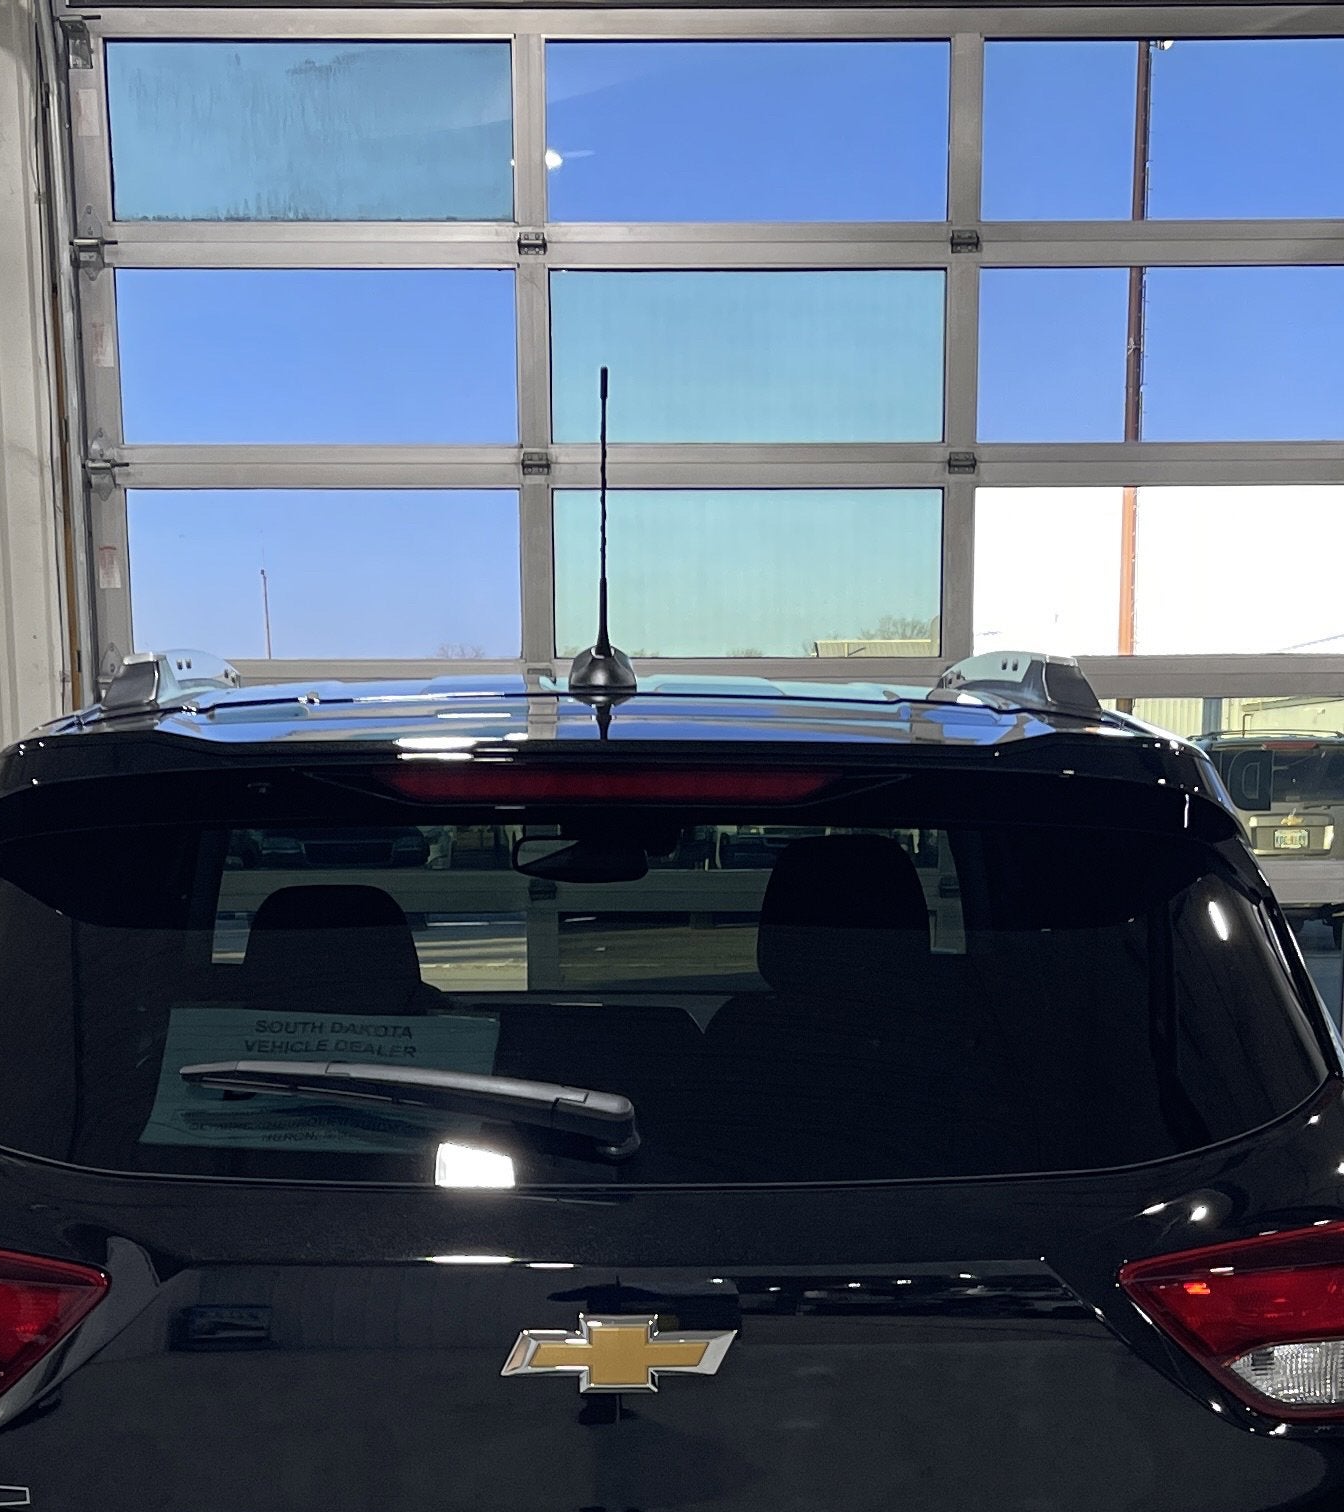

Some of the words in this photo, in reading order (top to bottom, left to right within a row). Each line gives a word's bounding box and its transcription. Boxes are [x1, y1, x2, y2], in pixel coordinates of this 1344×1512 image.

[256, 1019, 325, 1035] SOUTH
[330, 1020, 413, 1040] DAKOTA
[243, 1039, 327, 1054] VEHICLE
[334, 1040, 416, 1059] DEALER
